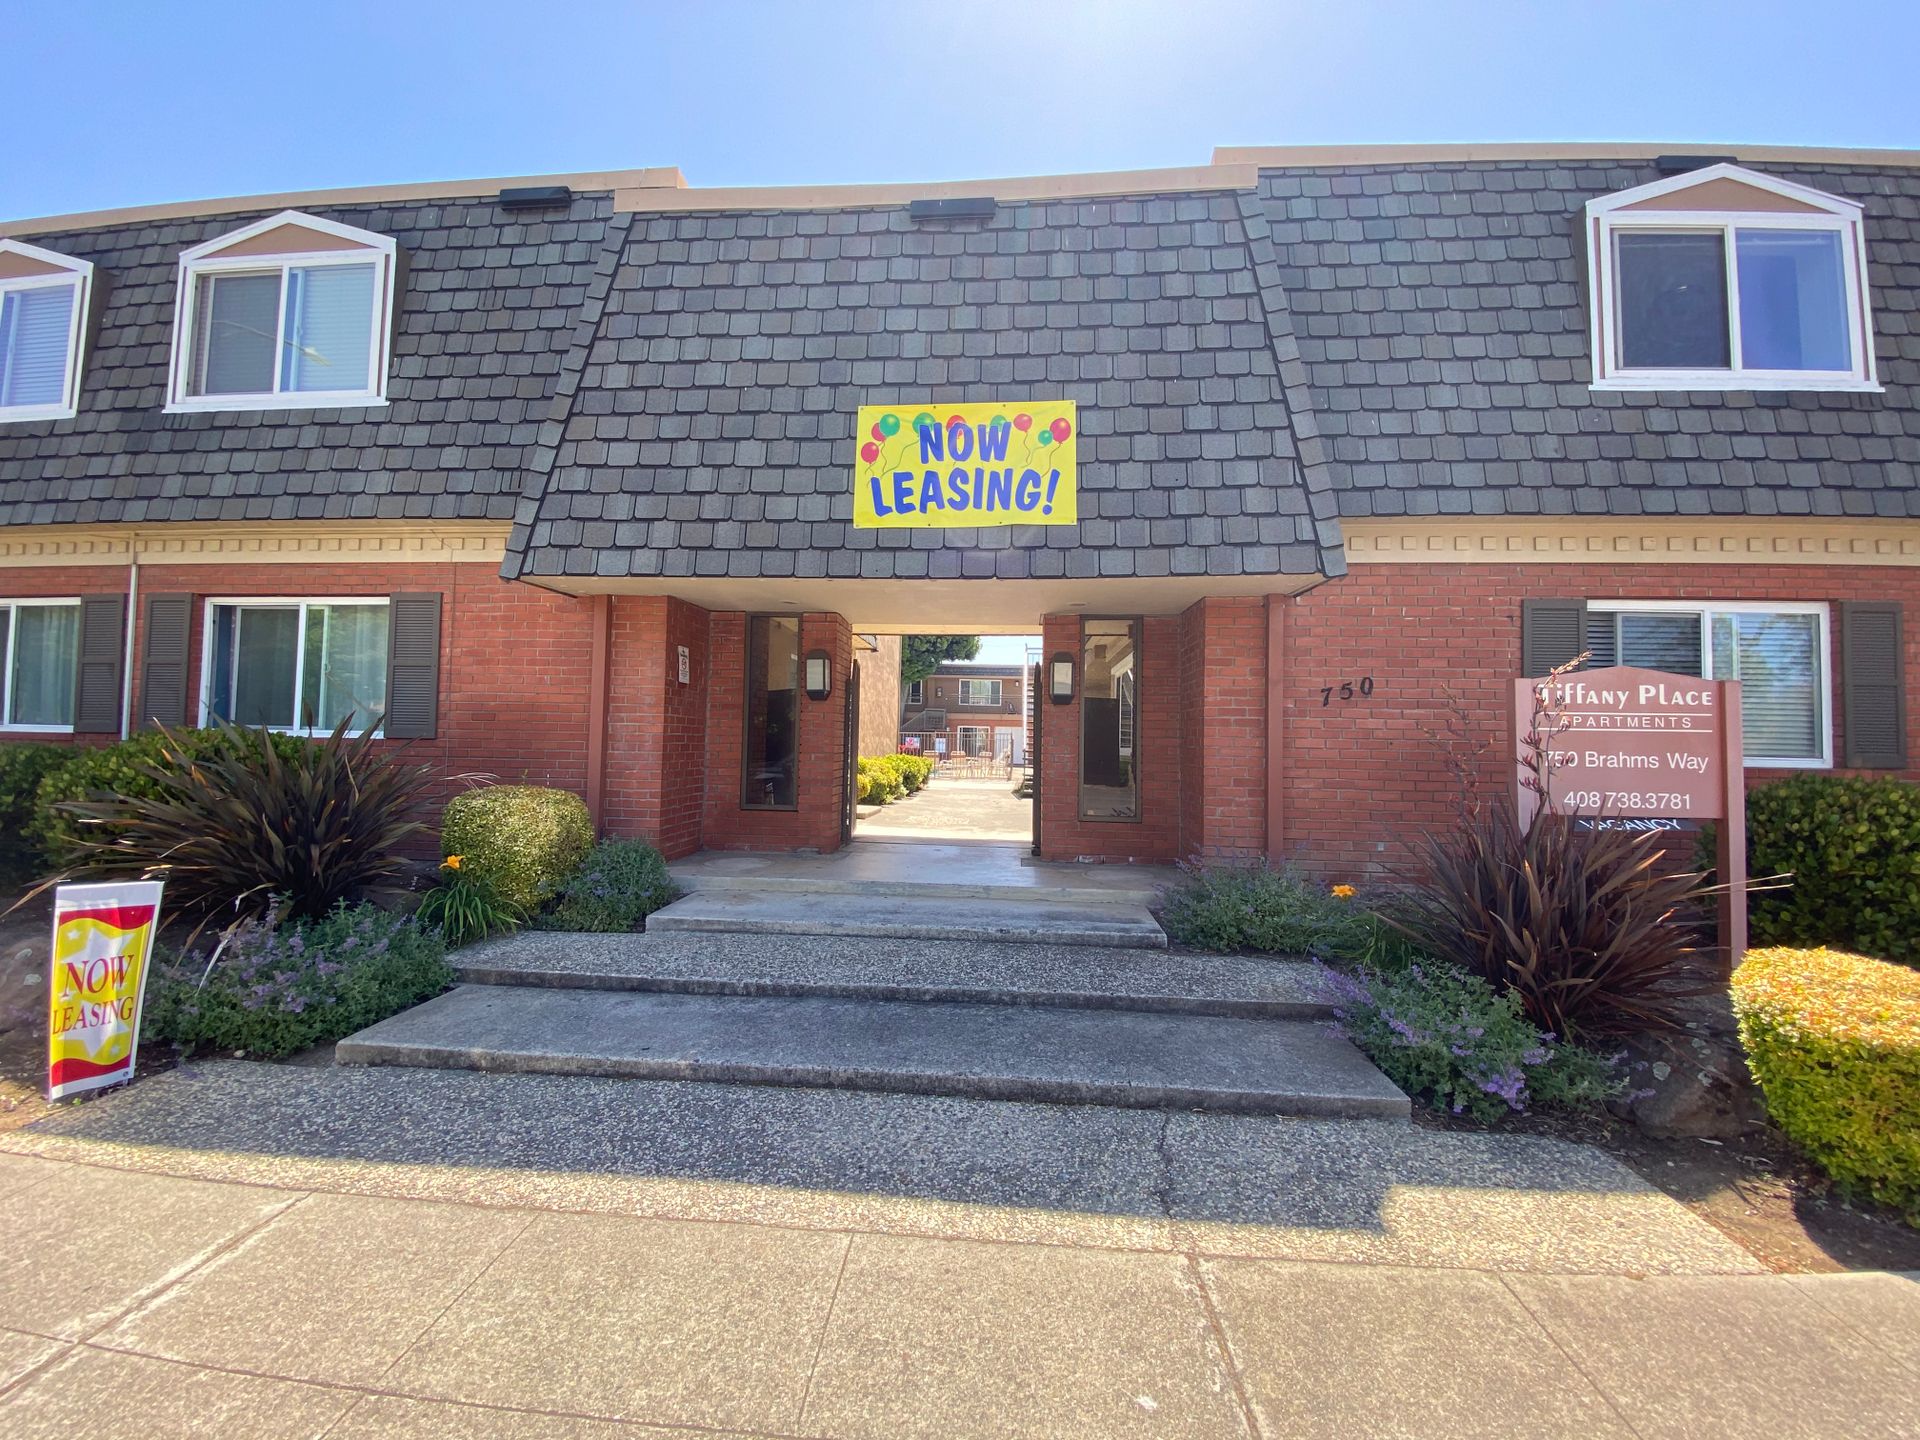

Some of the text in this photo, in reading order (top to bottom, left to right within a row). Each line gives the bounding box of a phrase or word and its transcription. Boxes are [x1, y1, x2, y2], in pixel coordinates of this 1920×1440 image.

[919, 421, 1012, 464] NOW
[870, 467, 1061, 517] LEASING!
[1320, 676, 1374, 707] 750
[1559, 715, 1692, 729] APARTMENTS
[1545, 751, 1709, 774] 750 Brahms Way
[62, 954, 134, 998] NOW
[52, 996, 134, 1036] LEASING
